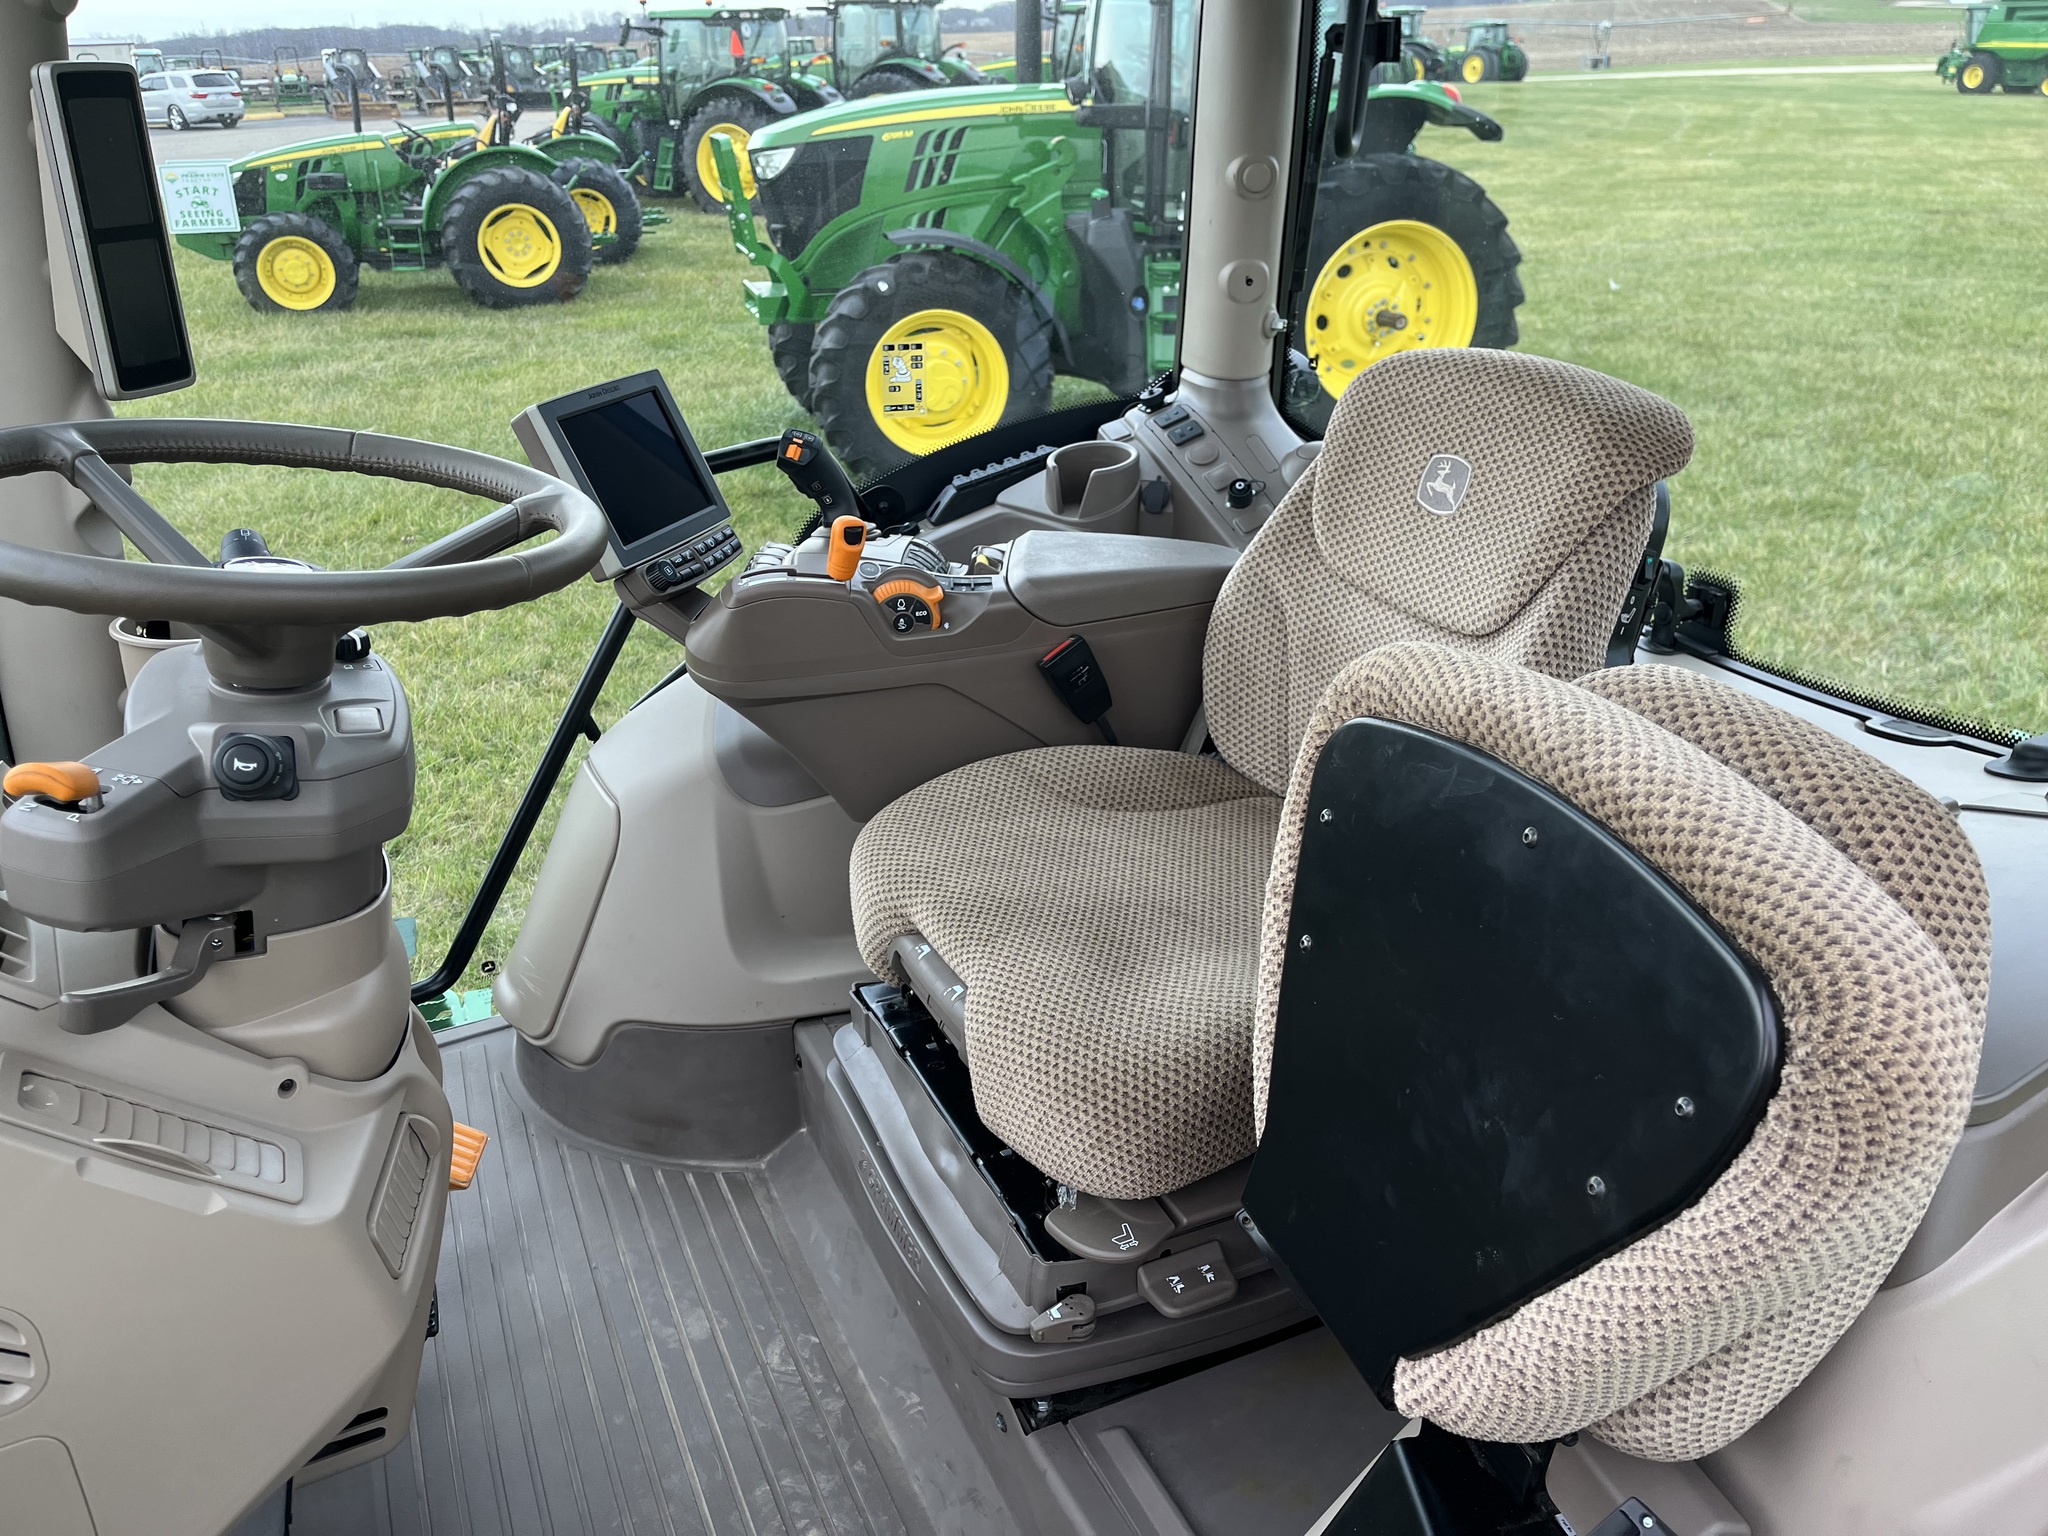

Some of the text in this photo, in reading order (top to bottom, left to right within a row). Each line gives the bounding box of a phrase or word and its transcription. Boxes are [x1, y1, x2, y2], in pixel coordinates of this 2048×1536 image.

[175, 186, 219, 198] START
[180, 209, 224, 219] SEEING
[175, 218, 232, 228] FARMERS
[602, 385, 621, 394] DEERE
